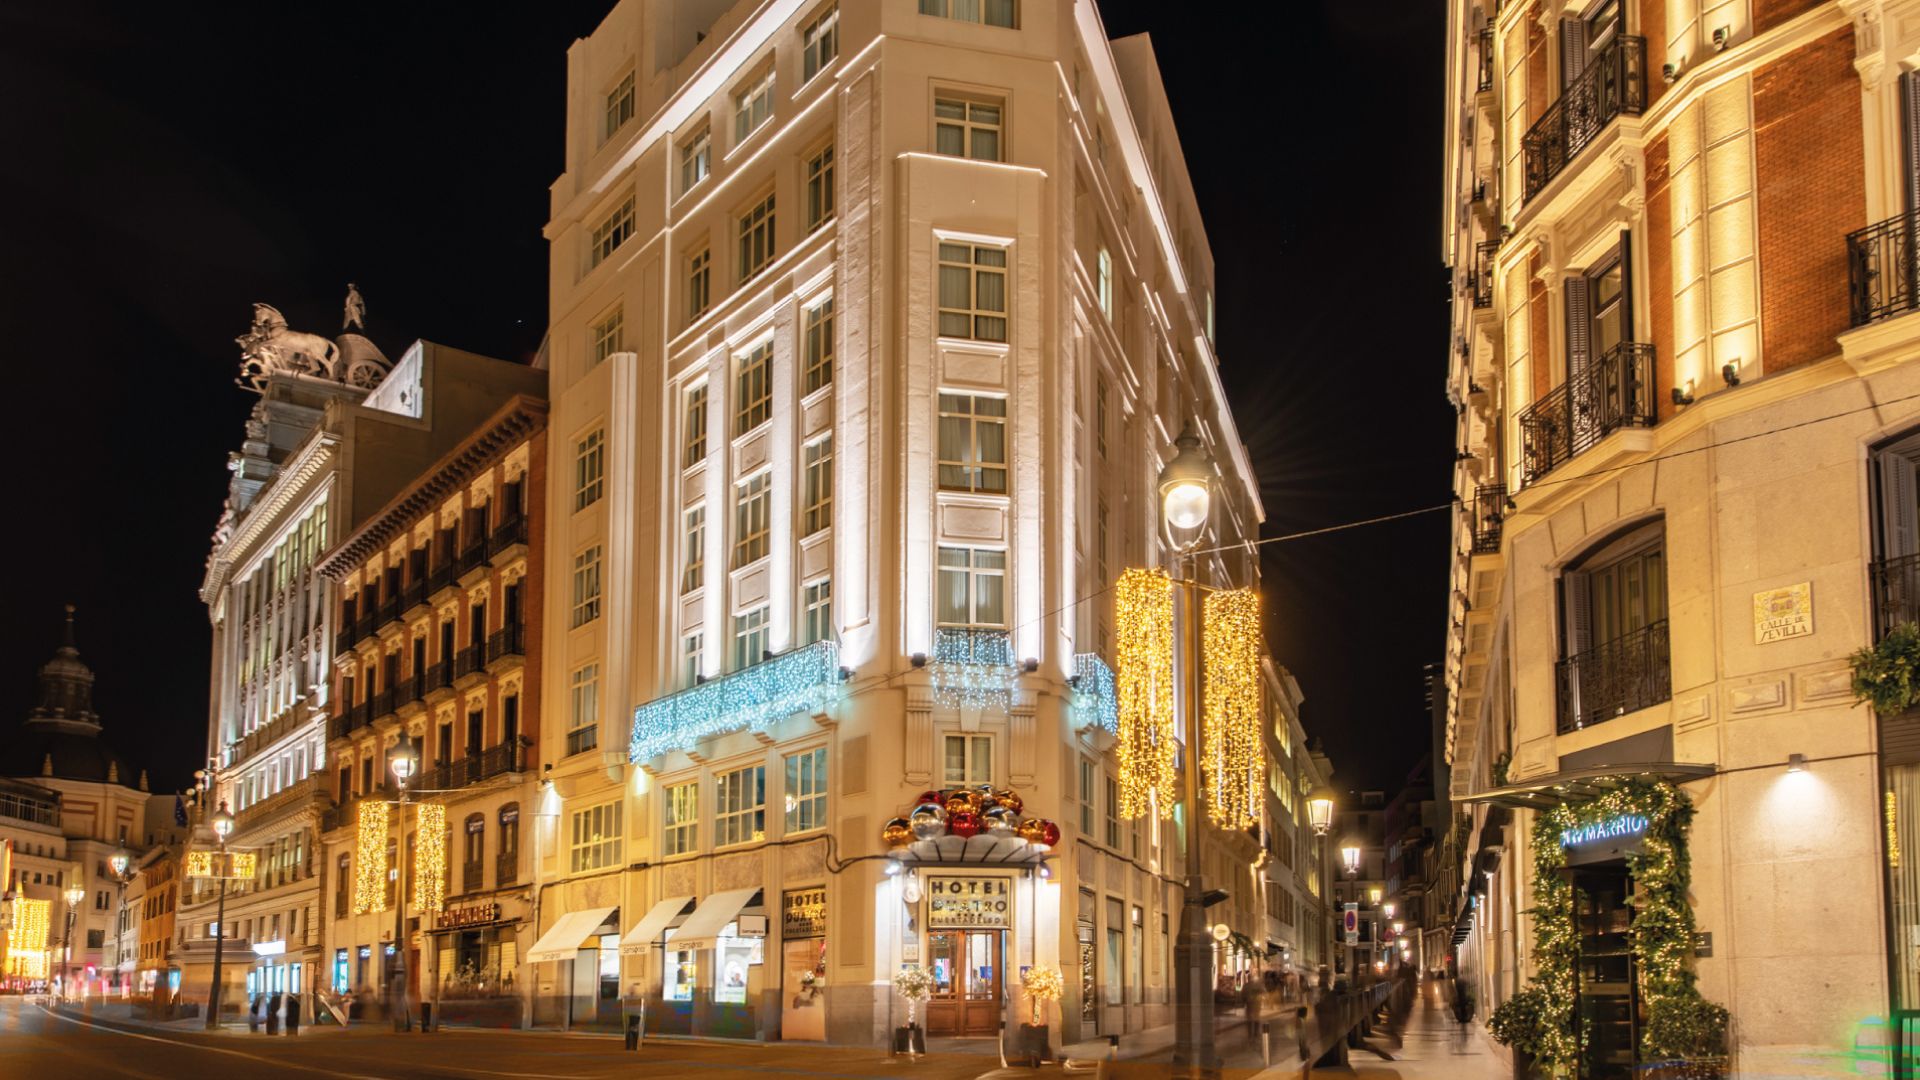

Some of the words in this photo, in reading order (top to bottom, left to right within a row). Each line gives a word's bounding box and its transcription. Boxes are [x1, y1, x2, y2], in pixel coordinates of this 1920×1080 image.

[1760, 618, 1792, 631] CALLE
[1795, 615, 1805, 623] DE
[1760, 625, 1807, 643] SEVILLA
[1585, 815, 1649, 841] MARRIO
[931, 881, 1007, 894] HOTEL
[786, 892, 826, 908] HOTEL
